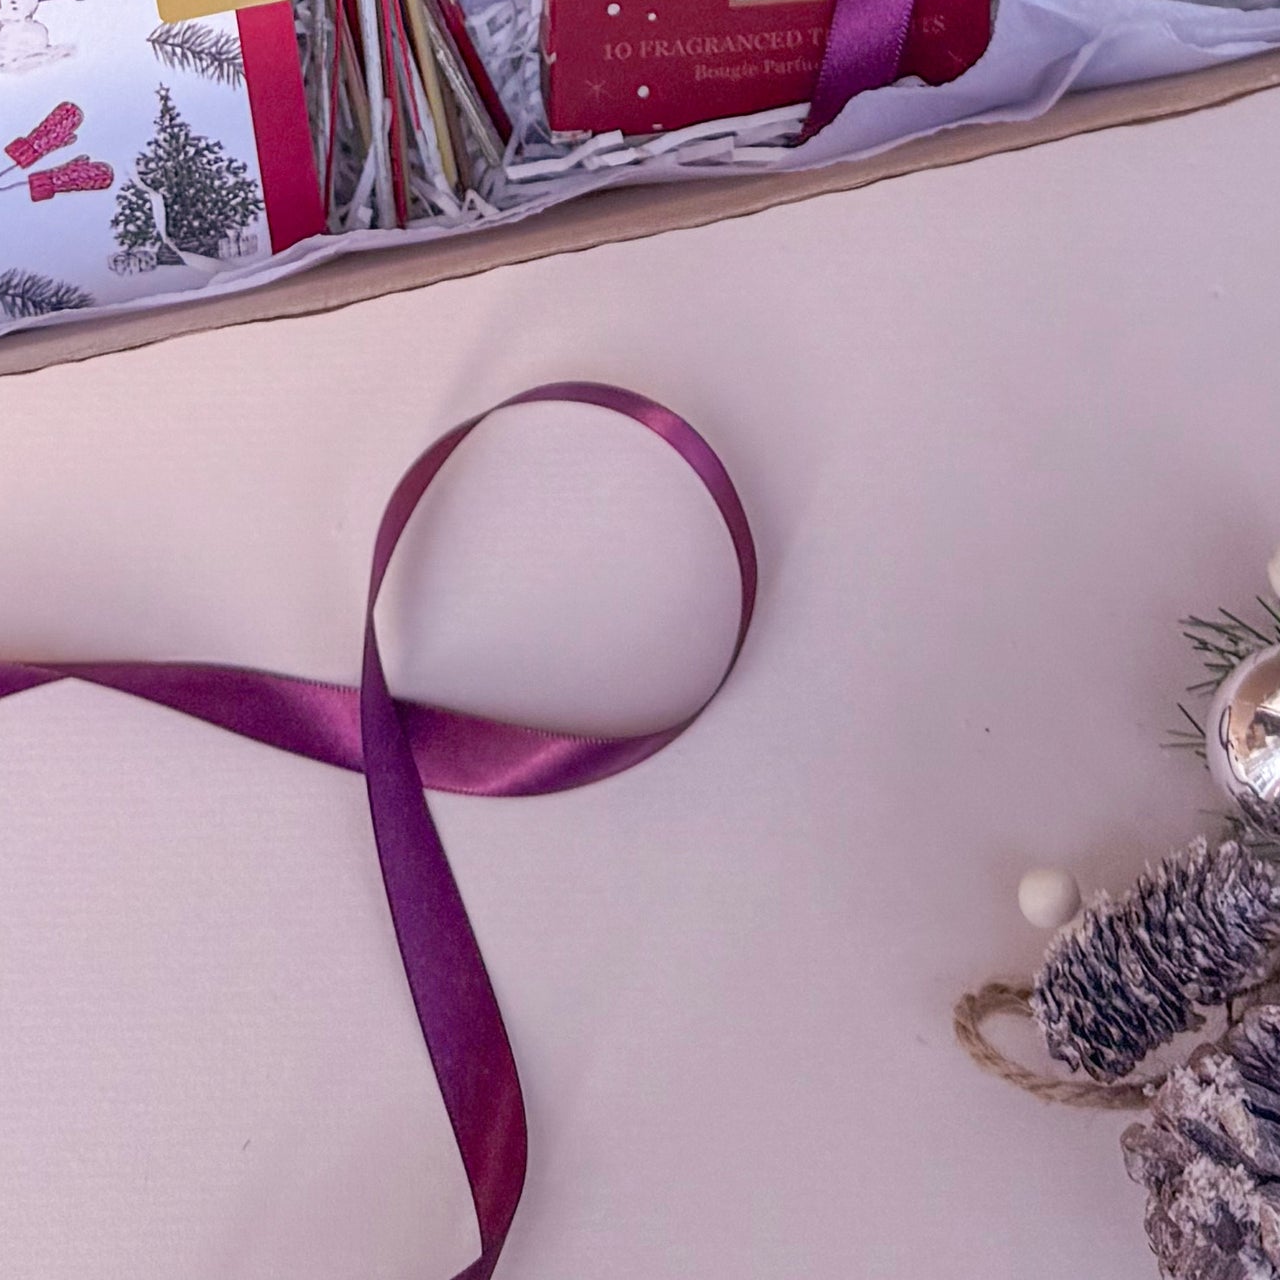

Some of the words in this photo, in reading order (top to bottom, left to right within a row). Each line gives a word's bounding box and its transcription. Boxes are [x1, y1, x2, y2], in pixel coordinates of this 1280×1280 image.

[603, 43, 632, 61] 10
[639, 30, 803, 59] FRAGRANCED
[762, 57, 820, 75] Parfu
